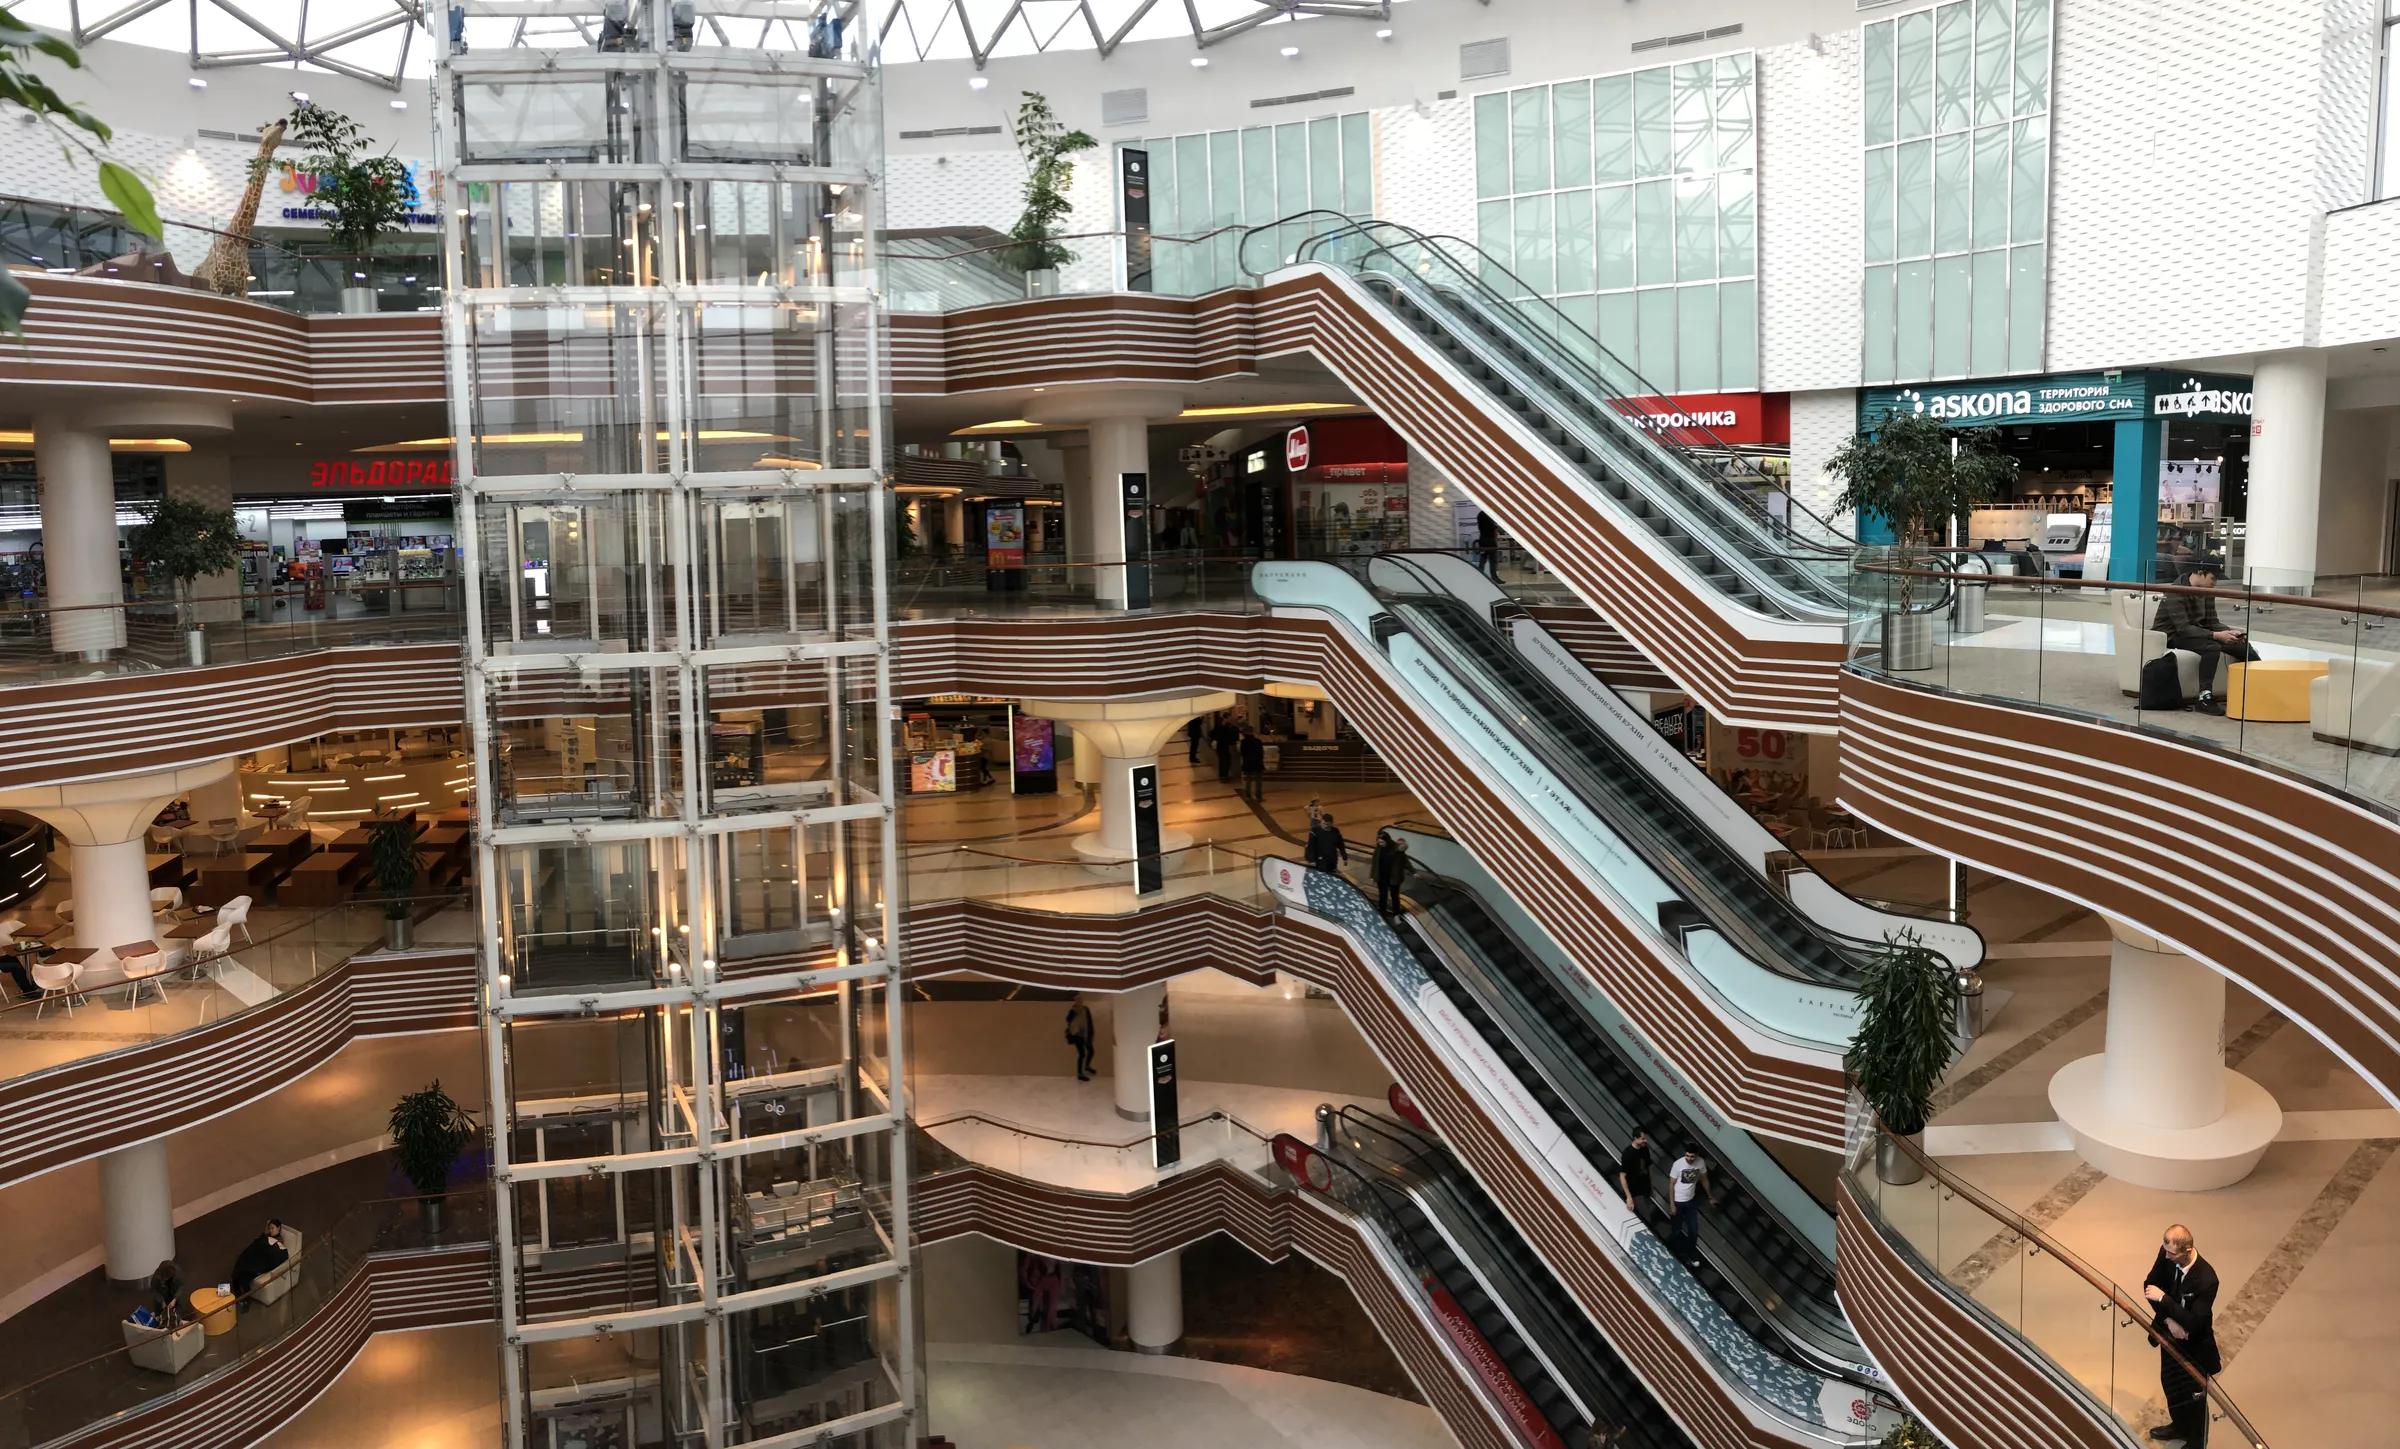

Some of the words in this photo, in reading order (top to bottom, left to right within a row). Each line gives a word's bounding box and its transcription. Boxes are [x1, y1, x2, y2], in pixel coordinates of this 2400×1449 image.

[1930, 389, 2031, 418] askona
[2040, 386, 2109, 398] ТЕРРИТОРИЯ
[2211, 389, 2253, 414] asko
[2038, 401, 2105, 413] ЗДОРОВОГО
[2109, 398, 2133, 410] СНА
[1624, 410, 1736, 434] ктроника
[309, 461, 475, 487] ЭЛЬДОРАД
[248, 514, 257, 533] 2
[1737, 728, 1786, 759] 50
[1798, 997, 1867, 1015] ZAFFERA
